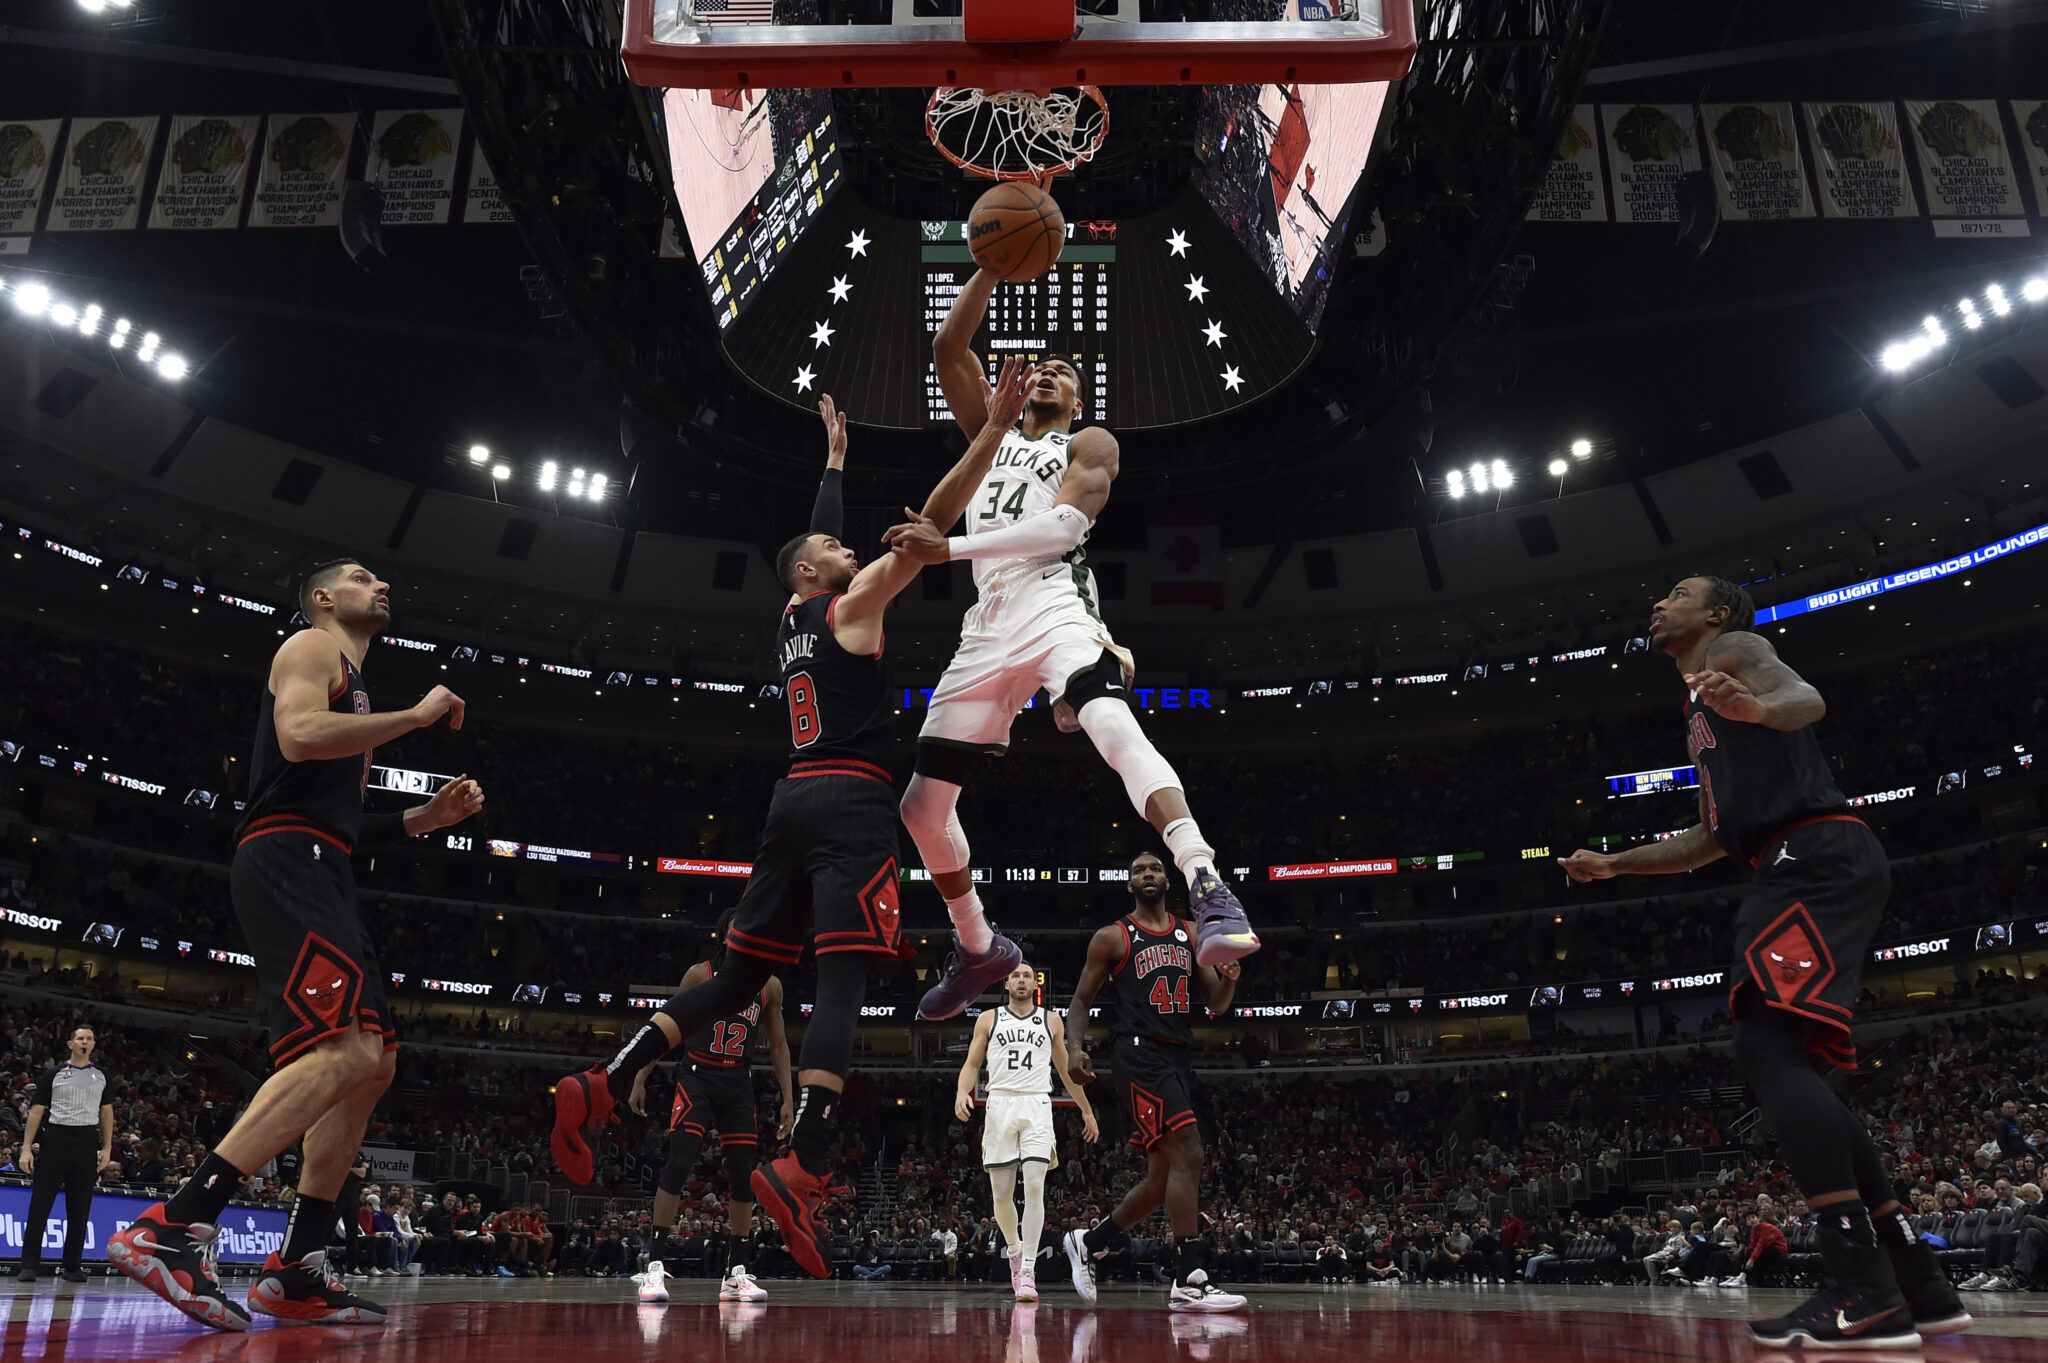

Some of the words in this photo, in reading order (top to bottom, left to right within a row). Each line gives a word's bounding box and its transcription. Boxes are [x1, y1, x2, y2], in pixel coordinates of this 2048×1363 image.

[1304, 7, 1325, 19] NBA
[1736, 161, 1782, 171] CHICAGO
[1838, 160, 1885, 170] CHICAGO
[1942, 158, 1989, 168] CHICAGO
[1633, 164, 1680, 173] CHICAGO
[1931, 168, 2005, 177] BLACKHAWKS
[280, 172, 325, 182] CHICAGO
[388, 169, 432, 179] CHICAGO
[1725, 171, 1799, 180] BLACKHAWKS
[1826, 170, 1900, 179] BLACKHAWKS
[80, 176, 123, 185] CHICAGO
[181, 175, 225, 184] CHICAGO
[1835, 179, 1895, 188] CAMPBELL
[1940, 177, 2000, 186] CAMPBELL
[165, 185, 235, 195] BLACKHAWKS
[265, 182, 335, 192] BLACKHAWKS
[1735, 181, 1794, 190] CAMPBELL
[1936, 186, 2009, 195] CONFERENCE
[64, 186, 133, 196] BLACKHAWKS
[410, 190, 450, 200] DIVISION
[1730, 190, 1802, 199] CONFERENCE
[1831, 188, 1904, 197] CONFERENCE
[56, 198, 93, 208] NORRIS
[157, 196, 194, 205] NORRIS
[257, 193, 295, 203] NORRIS
[1837, 198, 1901, 207] CHAMPIONS
[1943, 195, 2006, 205] CHAMPIONS
[266, 203, 326, 213] CHAMPIONS
[383, 201, 435, 211] HAMPIONS
[1737, 199, 1799, 209] CHAMPIONS
[64, 208, 122, 218] CHAMPIONS
[165, 207, 224, 217] CHAMPIONS
[381, 211, 433, 221] 009-2010
[1540, 210, 1581, 219] 2012-13
[1848, 207, 1895, 217] 1972-73
[1961, 223, 2003, 233] 1971-72
[927, 273, 934, 283] 11
[934, 273, 954, 283] LOPEZ
[924, 285, 934, 295] 34
[1015, 285, 1025, 295] 20
[1029, 285, 1037, 295] 10
[1047, 285, 1061, 295] 7/17
[924, 309, 934, 319] 24
[1030, 309, 1036, 319] 3
[926, 322, 934, 332] 12
[989, 322, 997, 332] 12
[1003, 322, 1009, 332] 2
[1047, 322, 1058, 332] 2/7
[990, 339, 1023, 349] CHICAGO
[1023, 339, 1047, 349] BULLS
[989, 362, 997, 372] 17
[925, 375, 934, 384] 44
[926, 387, 934, 396] 12
[1095, 399, 1106, 408] 2/2
[1095, 411, 1106, 420] 2/2
[995, 446, 1064, 482] UCKS
[979, 481, 1029, 520] 34
[60, 544, 103, 568] TISSOT
[1808, 594, 1838, 610] BUD
[1838, 581, 1881, 602] LIGHT
[1883, 556, 1972, 589] LEGENDS
[1973, 526, 2048, 563] LOUNGE
[234, 597, 277, 616] TISSOT
[397, 637, 437, 653] TISSOT
[779, 633, 818, 672] LAVINE
[1568, 646, 1607, 661] TISSOT
[555, 665, 593, 680] TISSOT
[1410, 673, 1448, 685] TISSOT
[708, 682, 745, 694] TISSOT
[1256, 686, 1293, 698] TISSOT
[787, 671, 822, 749] 8
[120, 775, 167, 796] TISSOT
[1864, 786, 1916, 805] TISSOT
[446, 835, 473, 851] 8:21
[527, 844, 556, 855] ARKANSAS
[1521, 846, 1550, 860] STEALS
[526, 852, 538, 860] LSU
[538, 853, 558, 862] TIGERS
[662, 859, 714, 872] Budweiser
[1273, 866, 1325, 878] Budweiser
[1328, 863, 1373, 874] CHAMPIONS
[1373, 862, 1392, 871] CLUB
[971, 870, 983, 881] 55
[1005, 868, 1036, 881] 11:13
[1067, 870, 1079, 881] 57
[1099, 868, 1129, 881] CHICAG
[5, 908, 62, 932] TISSOT
[1894, 938, 1949, 958] TISSOT
[1135, 944, 1192, 979] CHICAGO
[1671, 972, 1724, 989] TISSOT
[441, 982, 493, 996] TISSOT
[1150, 976, 1190, 1014] 44
[1459, 994, 1508, 1007] TISSOT
[1253, 1005, 1302, 1017] TISSOT
[710, 1020, 747, 1056] 12
[996, 1029, 1046, 1049] BUCKS
[1008, 1050, 1033, 1070] 24
